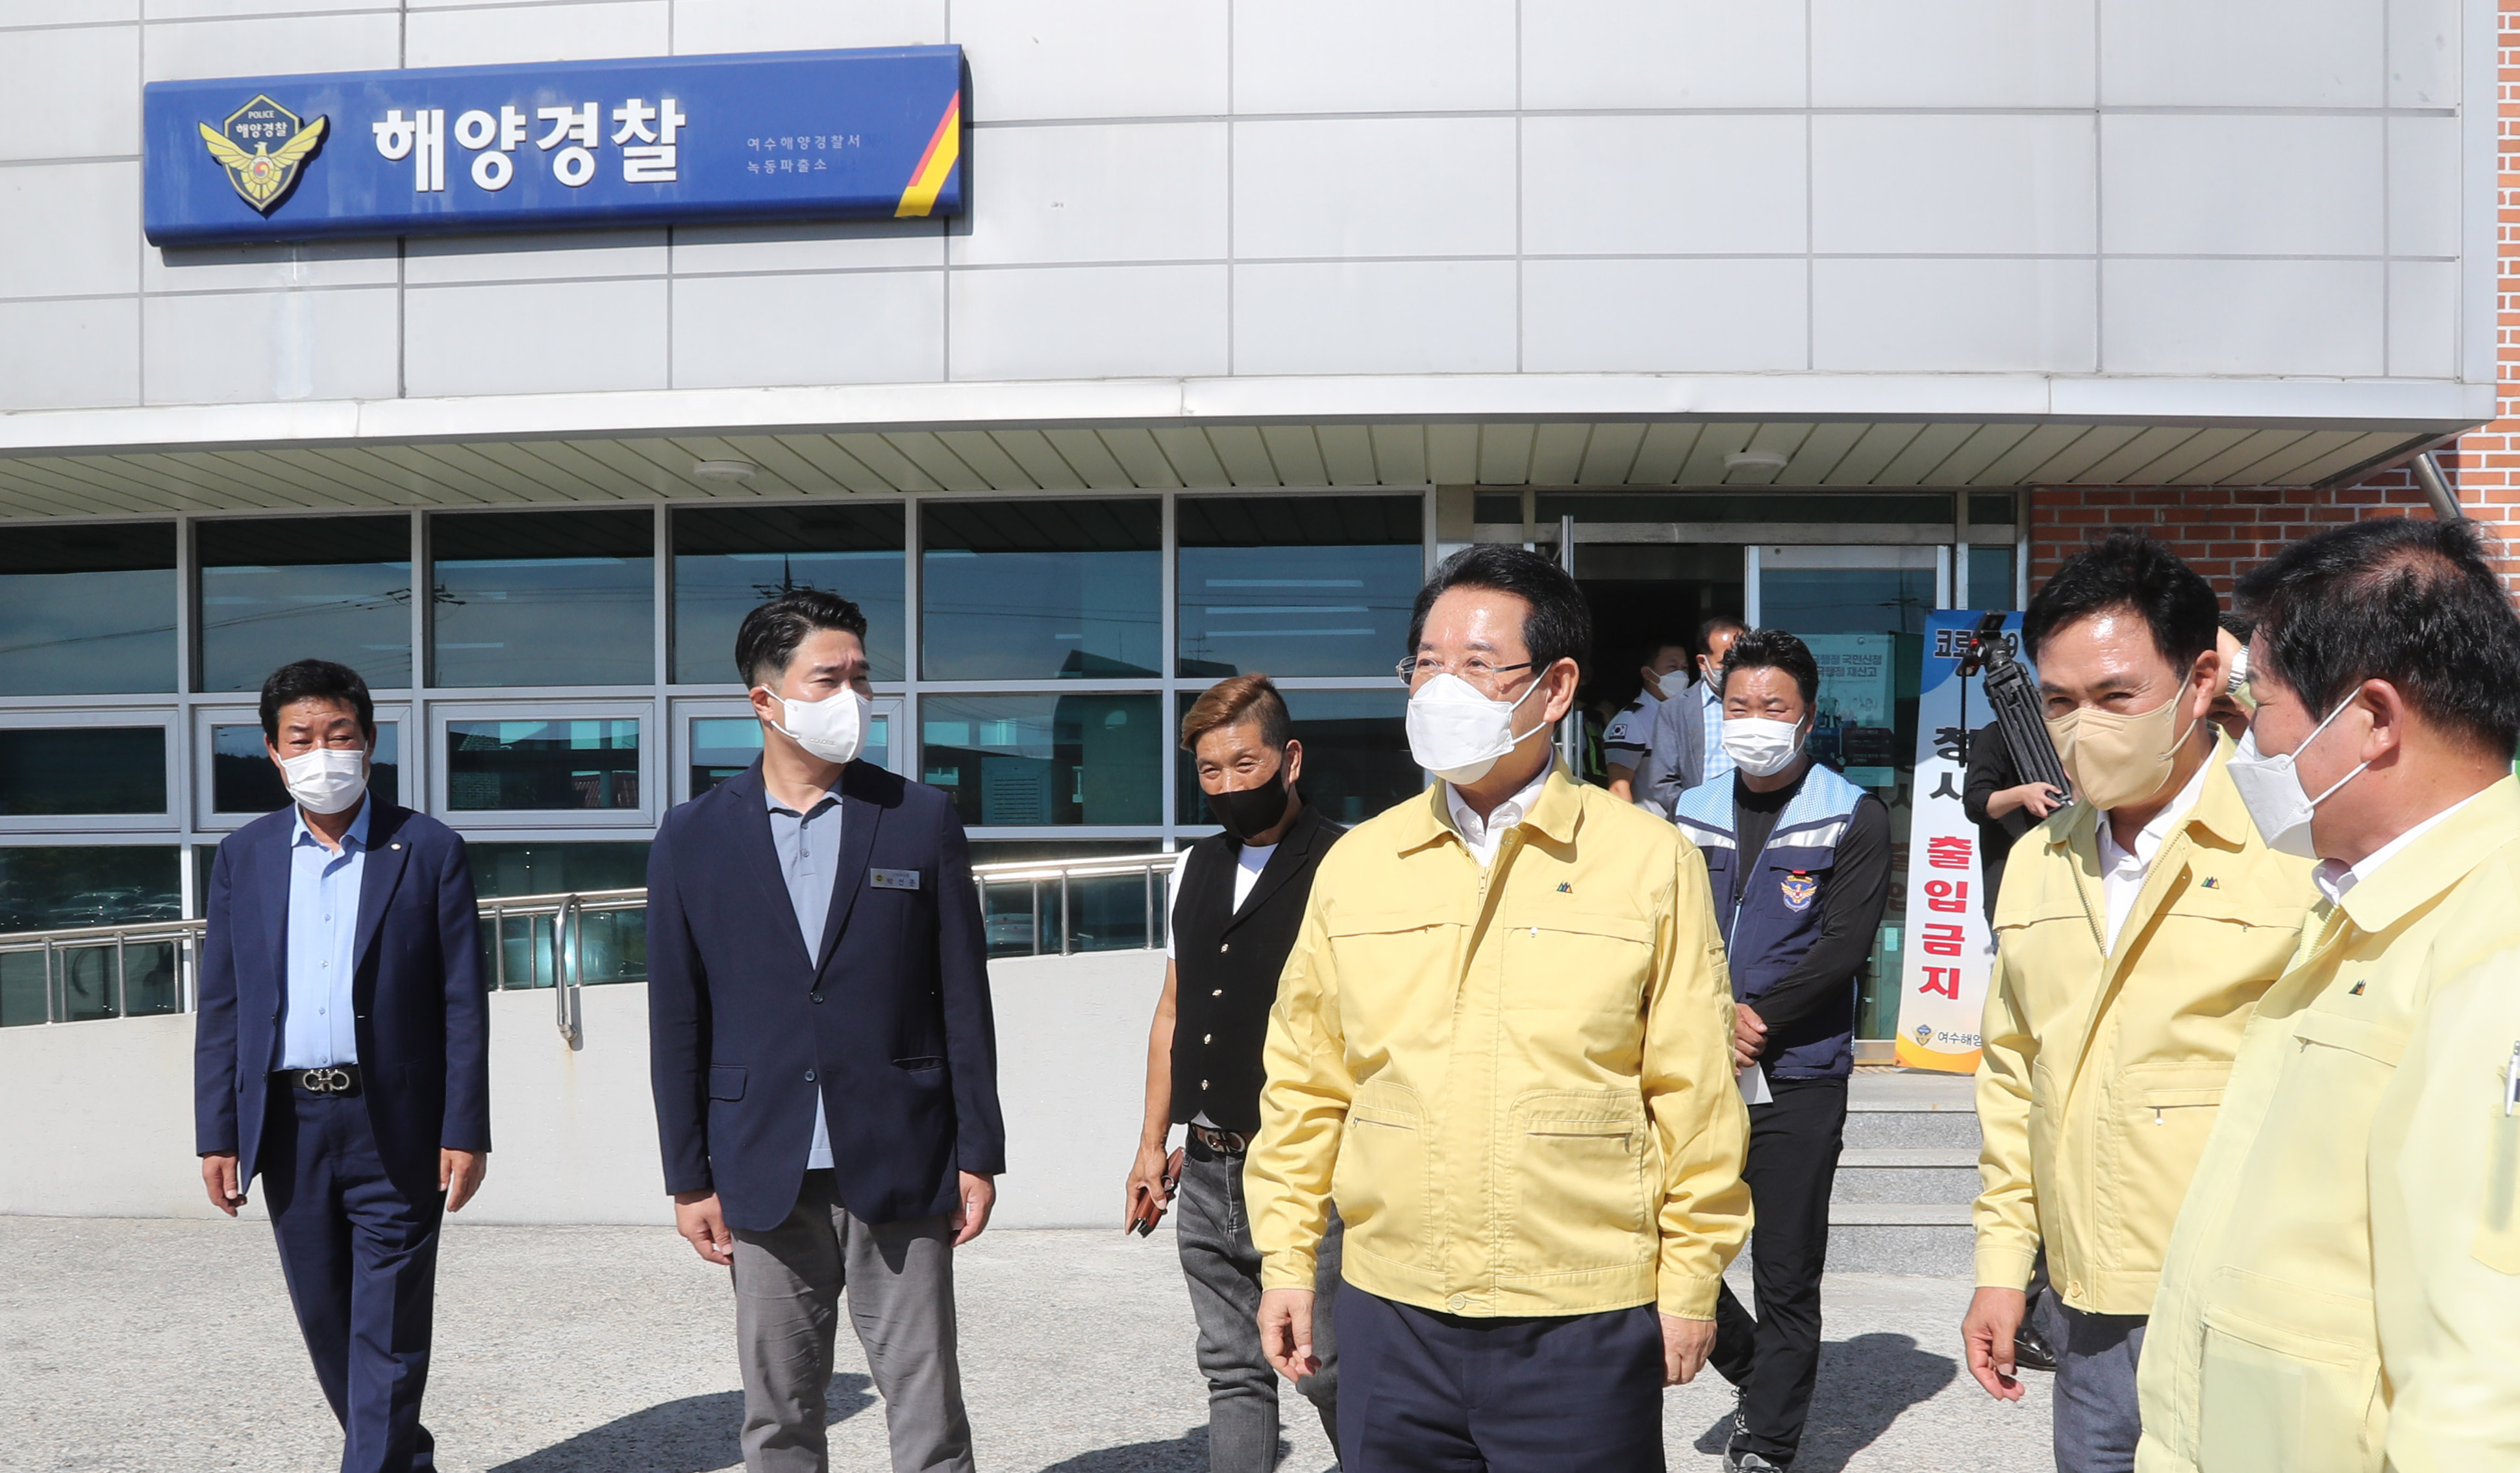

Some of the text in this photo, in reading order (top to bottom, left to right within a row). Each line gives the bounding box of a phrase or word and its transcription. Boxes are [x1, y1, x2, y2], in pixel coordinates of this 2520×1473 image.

[247, 110, 275, 120] POLICE
[235, 121, 288, 138] 해양경찰
[372, 98, 686, 192] 해양경찰
[747, 134, 860, 151] 여수해양경찰서
[747, 158, 827, 174] 녹동파출소
[1934, 629, 2018, 660] 코로9
[1842, 654, 1882, 665] 국민신청
[1847, 666, 1877, 677] 재신고
[1918, 836, 1973, 1000] 출입금지
